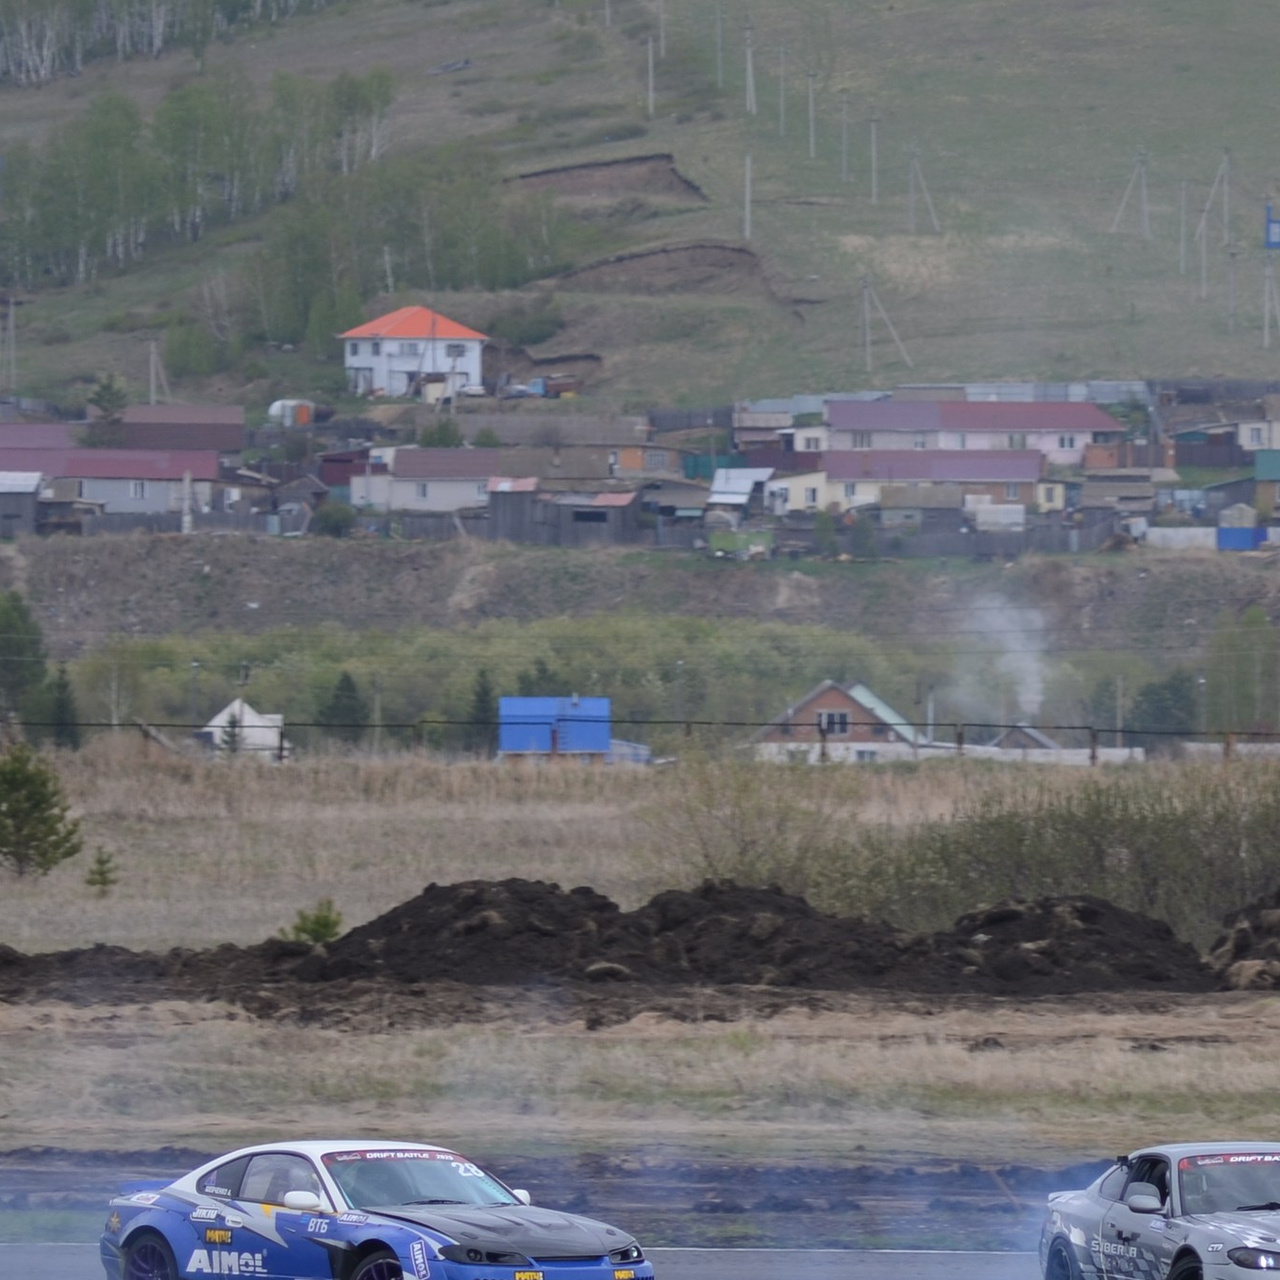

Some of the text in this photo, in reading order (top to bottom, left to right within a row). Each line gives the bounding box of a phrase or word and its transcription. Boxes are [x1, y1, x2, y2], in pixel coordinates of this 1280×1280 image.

[1230, 1155, 1262, 1163] DRIFT
[451, 1162, 485, 1177] 28
[307, 1218, 330, 1233] ВТБ
[340, 1213, 367, 1223] AIMOL
[186, 1249, 268, 1276] AIMOL
[413, 1243, 427, 1278] AIMOL
